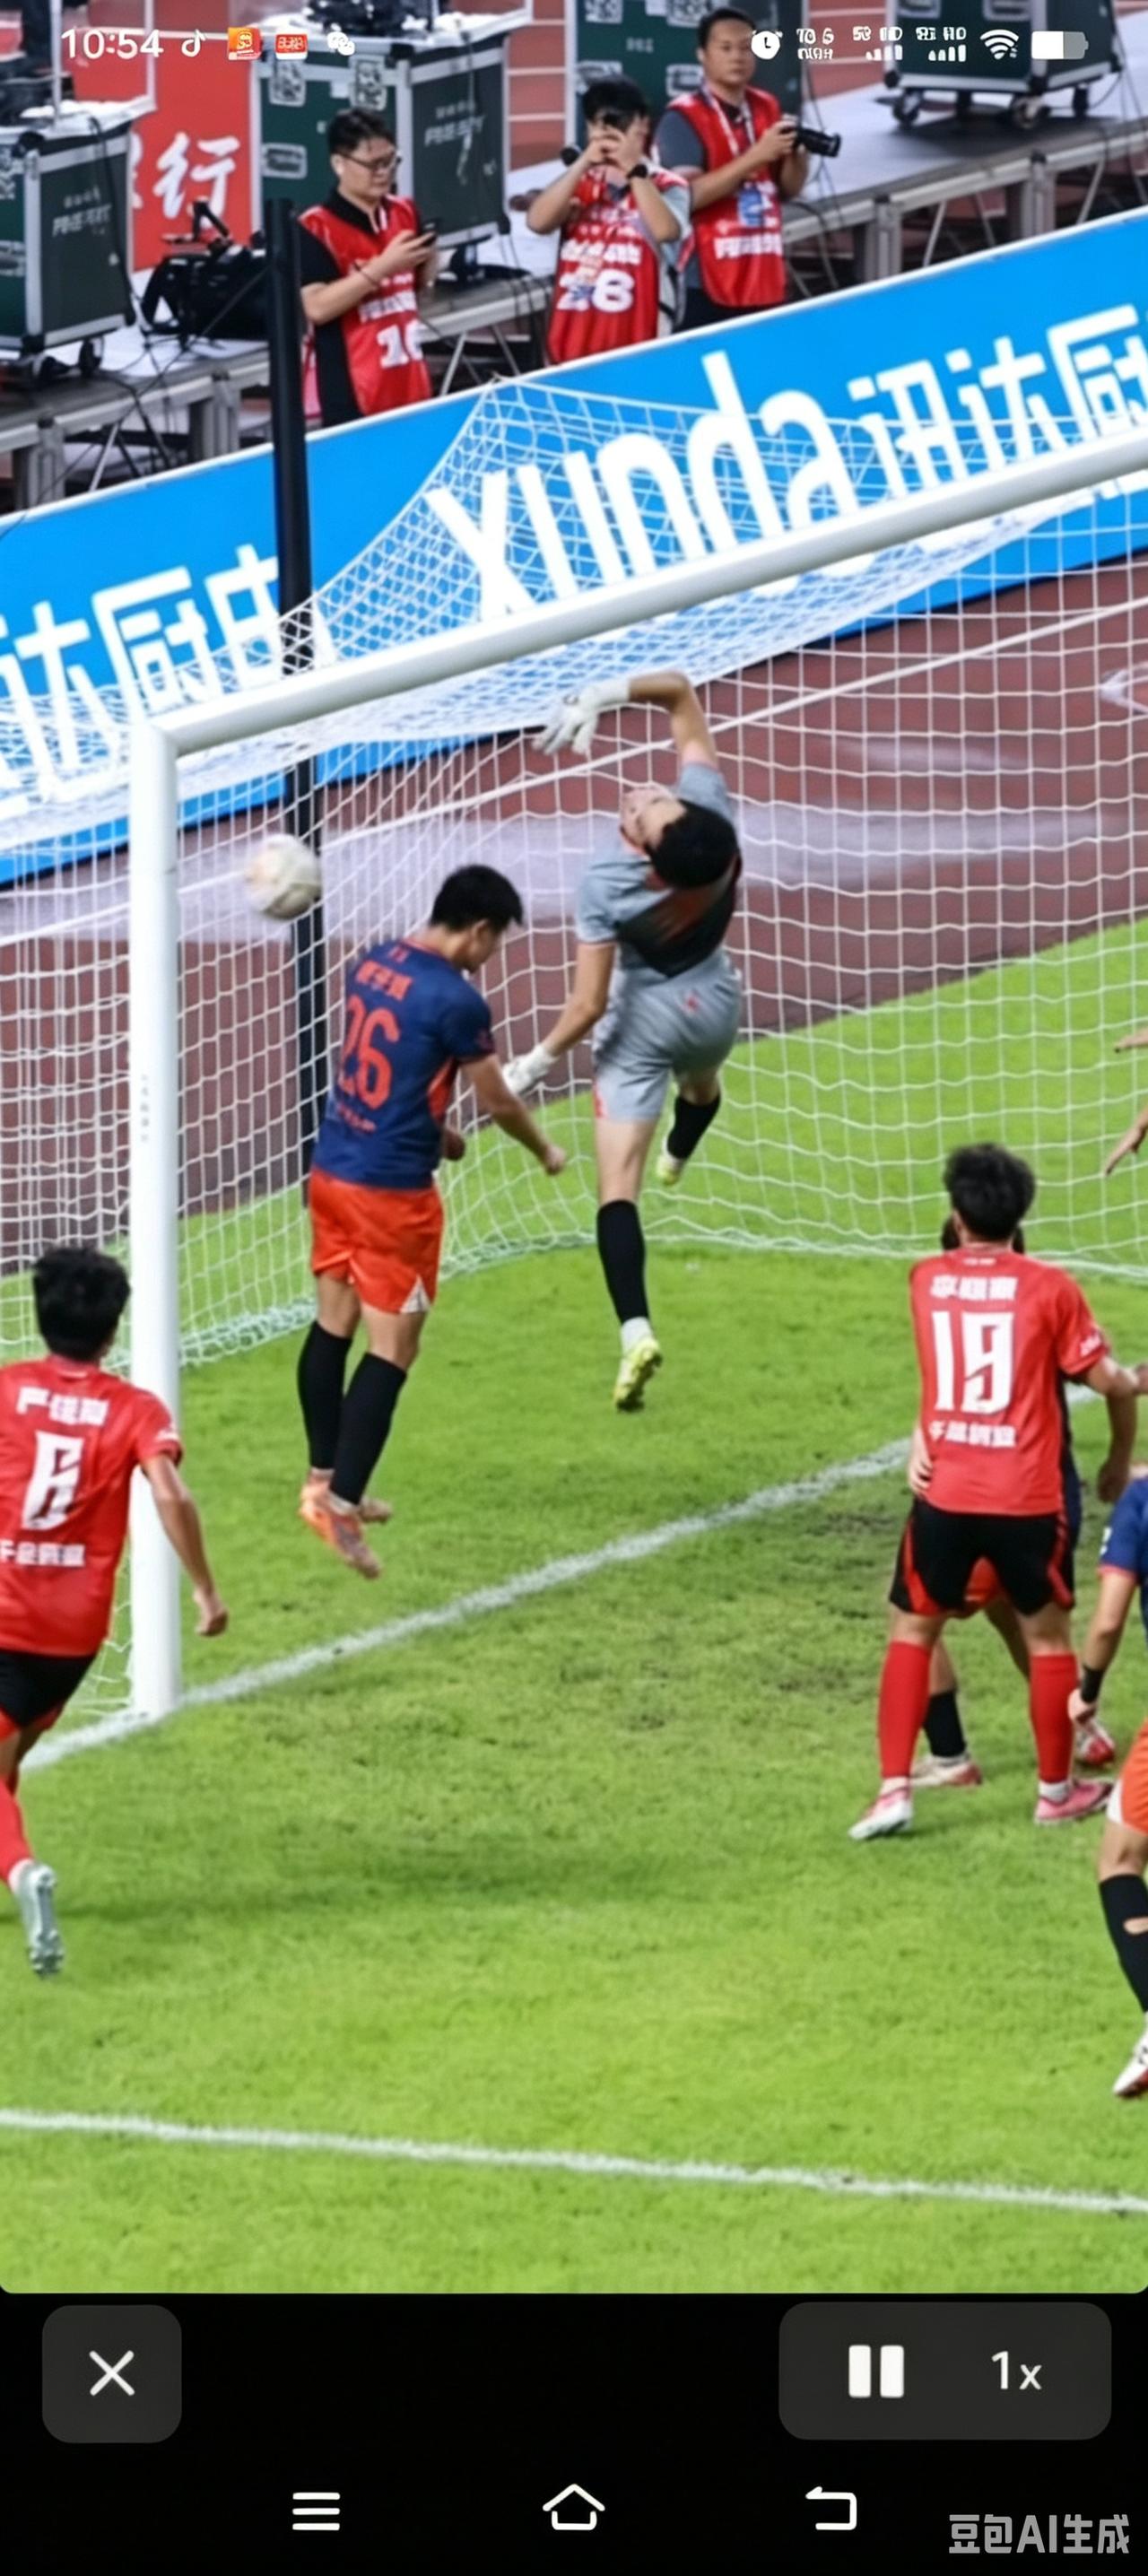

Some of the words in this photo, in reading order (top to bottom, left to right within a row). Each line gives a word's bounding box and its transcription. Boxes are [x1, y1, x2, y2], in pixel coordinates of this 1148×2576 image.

[133, 131, 240, 228] 行
[337, 995, 400, 1110] 26
[931, 1310, 1014, 1414] 19
